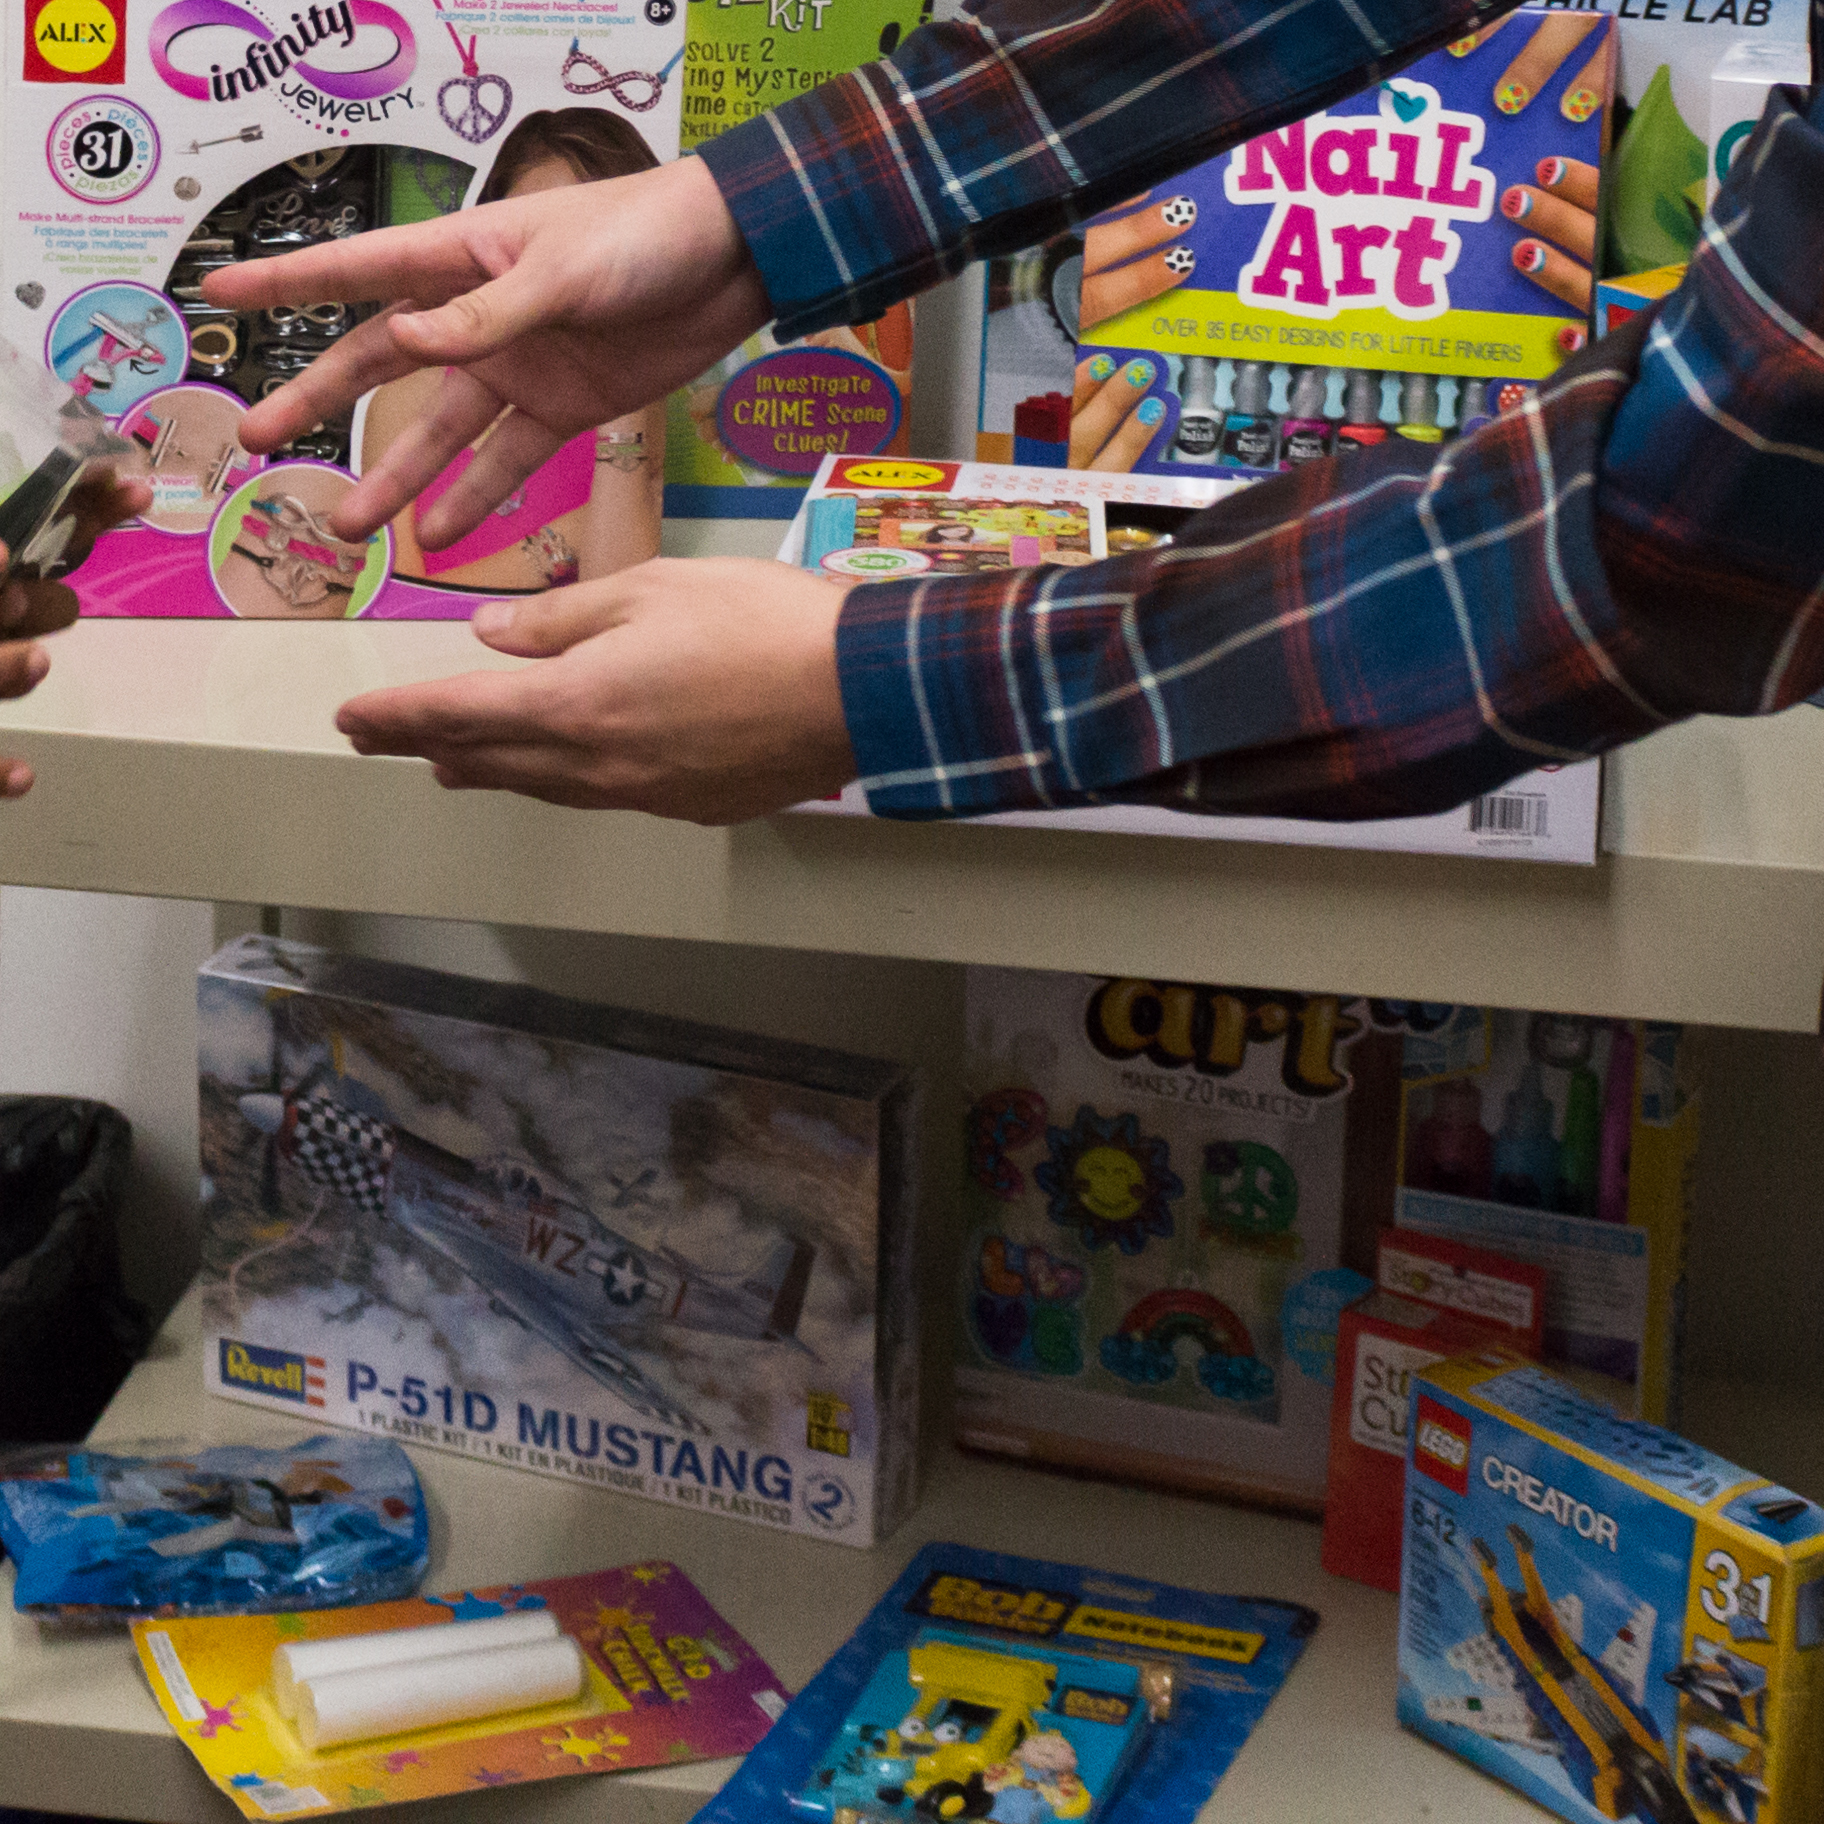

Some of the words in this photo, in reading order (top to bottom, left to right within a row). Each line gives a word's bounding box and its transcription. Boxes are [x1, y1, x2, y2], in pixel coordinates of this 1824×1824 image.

[489, 12, 496, 22] 2
[578, 14, 593, 24] de
[490, 0, 498, 10] 2
[500, 1, 550, 12] Jeweled
[553, 1, 618, 13] Necklaces!
[650, 2, 672, 18] 8+
[39, 22, 107, 43] ALEX
[493, 26, 500, 35] 2
[686, 40, 751, 63] SOLVE
[759, 37, 775, 62] 2
[210, 0, 357, 103] infinity
[685, 66, 725, 93] ing
[685, 95, 726, 116] ime
[57, 111, 92, 170] pieces
[75, 169, 139, 193] piezas
[80, 128, 124, 171] 31
[18, 212, 52, 223] Make
[55, 212, 125, 224] Multi-strand
[1251, 203, 1447, 308] Art
[1151, 316, 1198, 338] OVER
[1229, 322, 1274, 344] EASY
[1278, 326, 1346, 350] DESIGNS
[1350, 331, 1385, 352] FOR
[1388, 334, 1450, 358] LITTLE
[1455, 339, 1523, 363] FINGERS
[733, 398, 816, 427] CRIME
[827, 403, 887, 425] Scene
[853, 468, 932, 480] ALEX
[1088, 977, 1363, 1092] art
[1121, 1070, 1178, 1097] MAKES
[1183, 1078, 1216, 1104] 20
[1217, 1087, 1316, 1120] PROJECTS!
[227, 1344, 303, 1393] Revell
[347, 1360, 498, 1433] P-51D
[518, 1402, 793, 1503] MUSTANG
[1419, 1422, 1467, 1465] LEGO
[371, 1411, 439, 1442] PLASTIC
[442, 1427, 467, 1449] KIT
[497, 1442, 523, 1463] KIT
[528, 1449, 551, 1469] EN
[554, 1454, 645, 1493] PLASTIQUE
[677, 1484, 704, 1504] KIT
[811, 1483, 844, 1521] 2
[1482, 1455, 1618, 1552] CREATOR
[1411, 1499, 1456, 1546] 6-12
